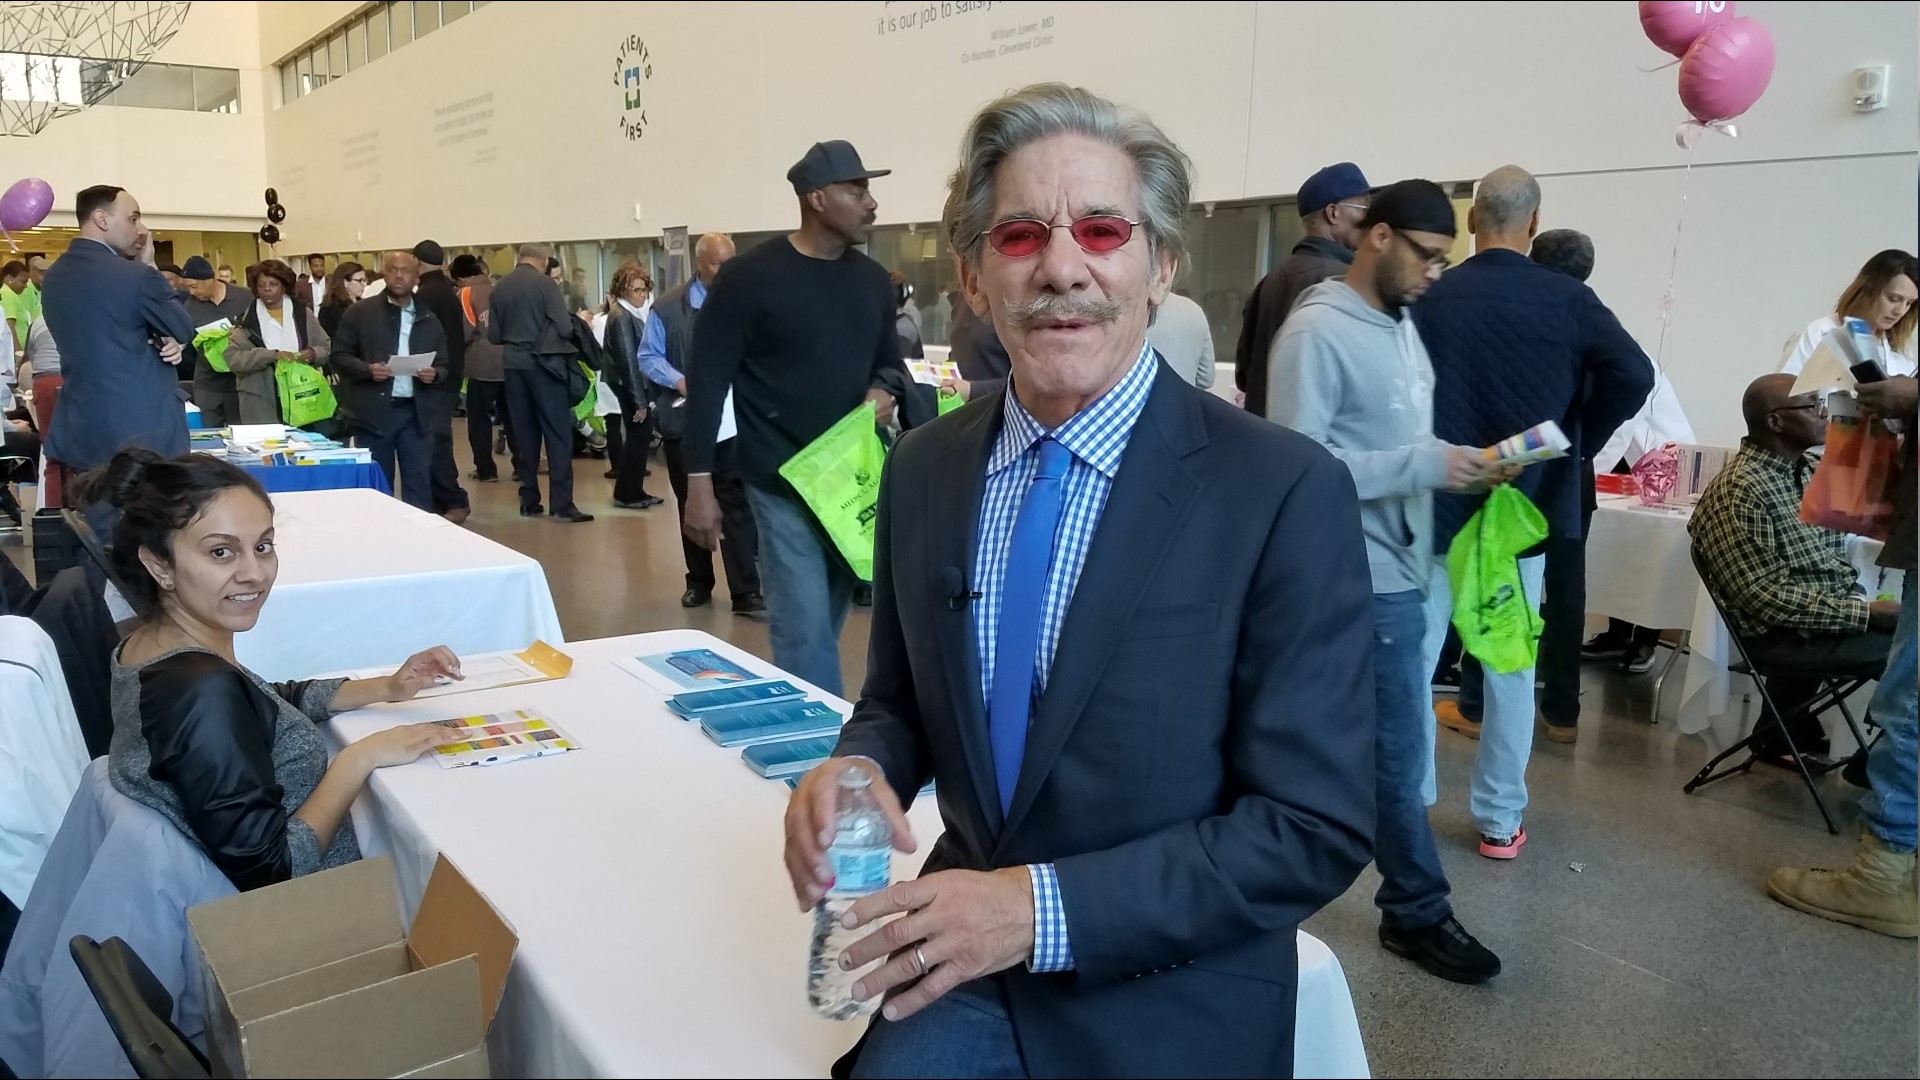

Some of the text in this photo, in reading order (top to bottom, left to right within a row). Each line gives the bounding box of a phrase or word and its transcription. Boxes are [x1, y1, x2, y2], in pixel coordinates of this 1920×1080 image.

[878, 17, 885, 35] it
[888, 15, 896, 32] is
[899, 13, 917, 30] our
[920, 3, 937, 29] job
[941, 1, 951, 18] to
[1041, 16, 1054, 29] MD
[613, 34, 652, 86] PATIENTS
[619, 109, 648, 141] FIRST
